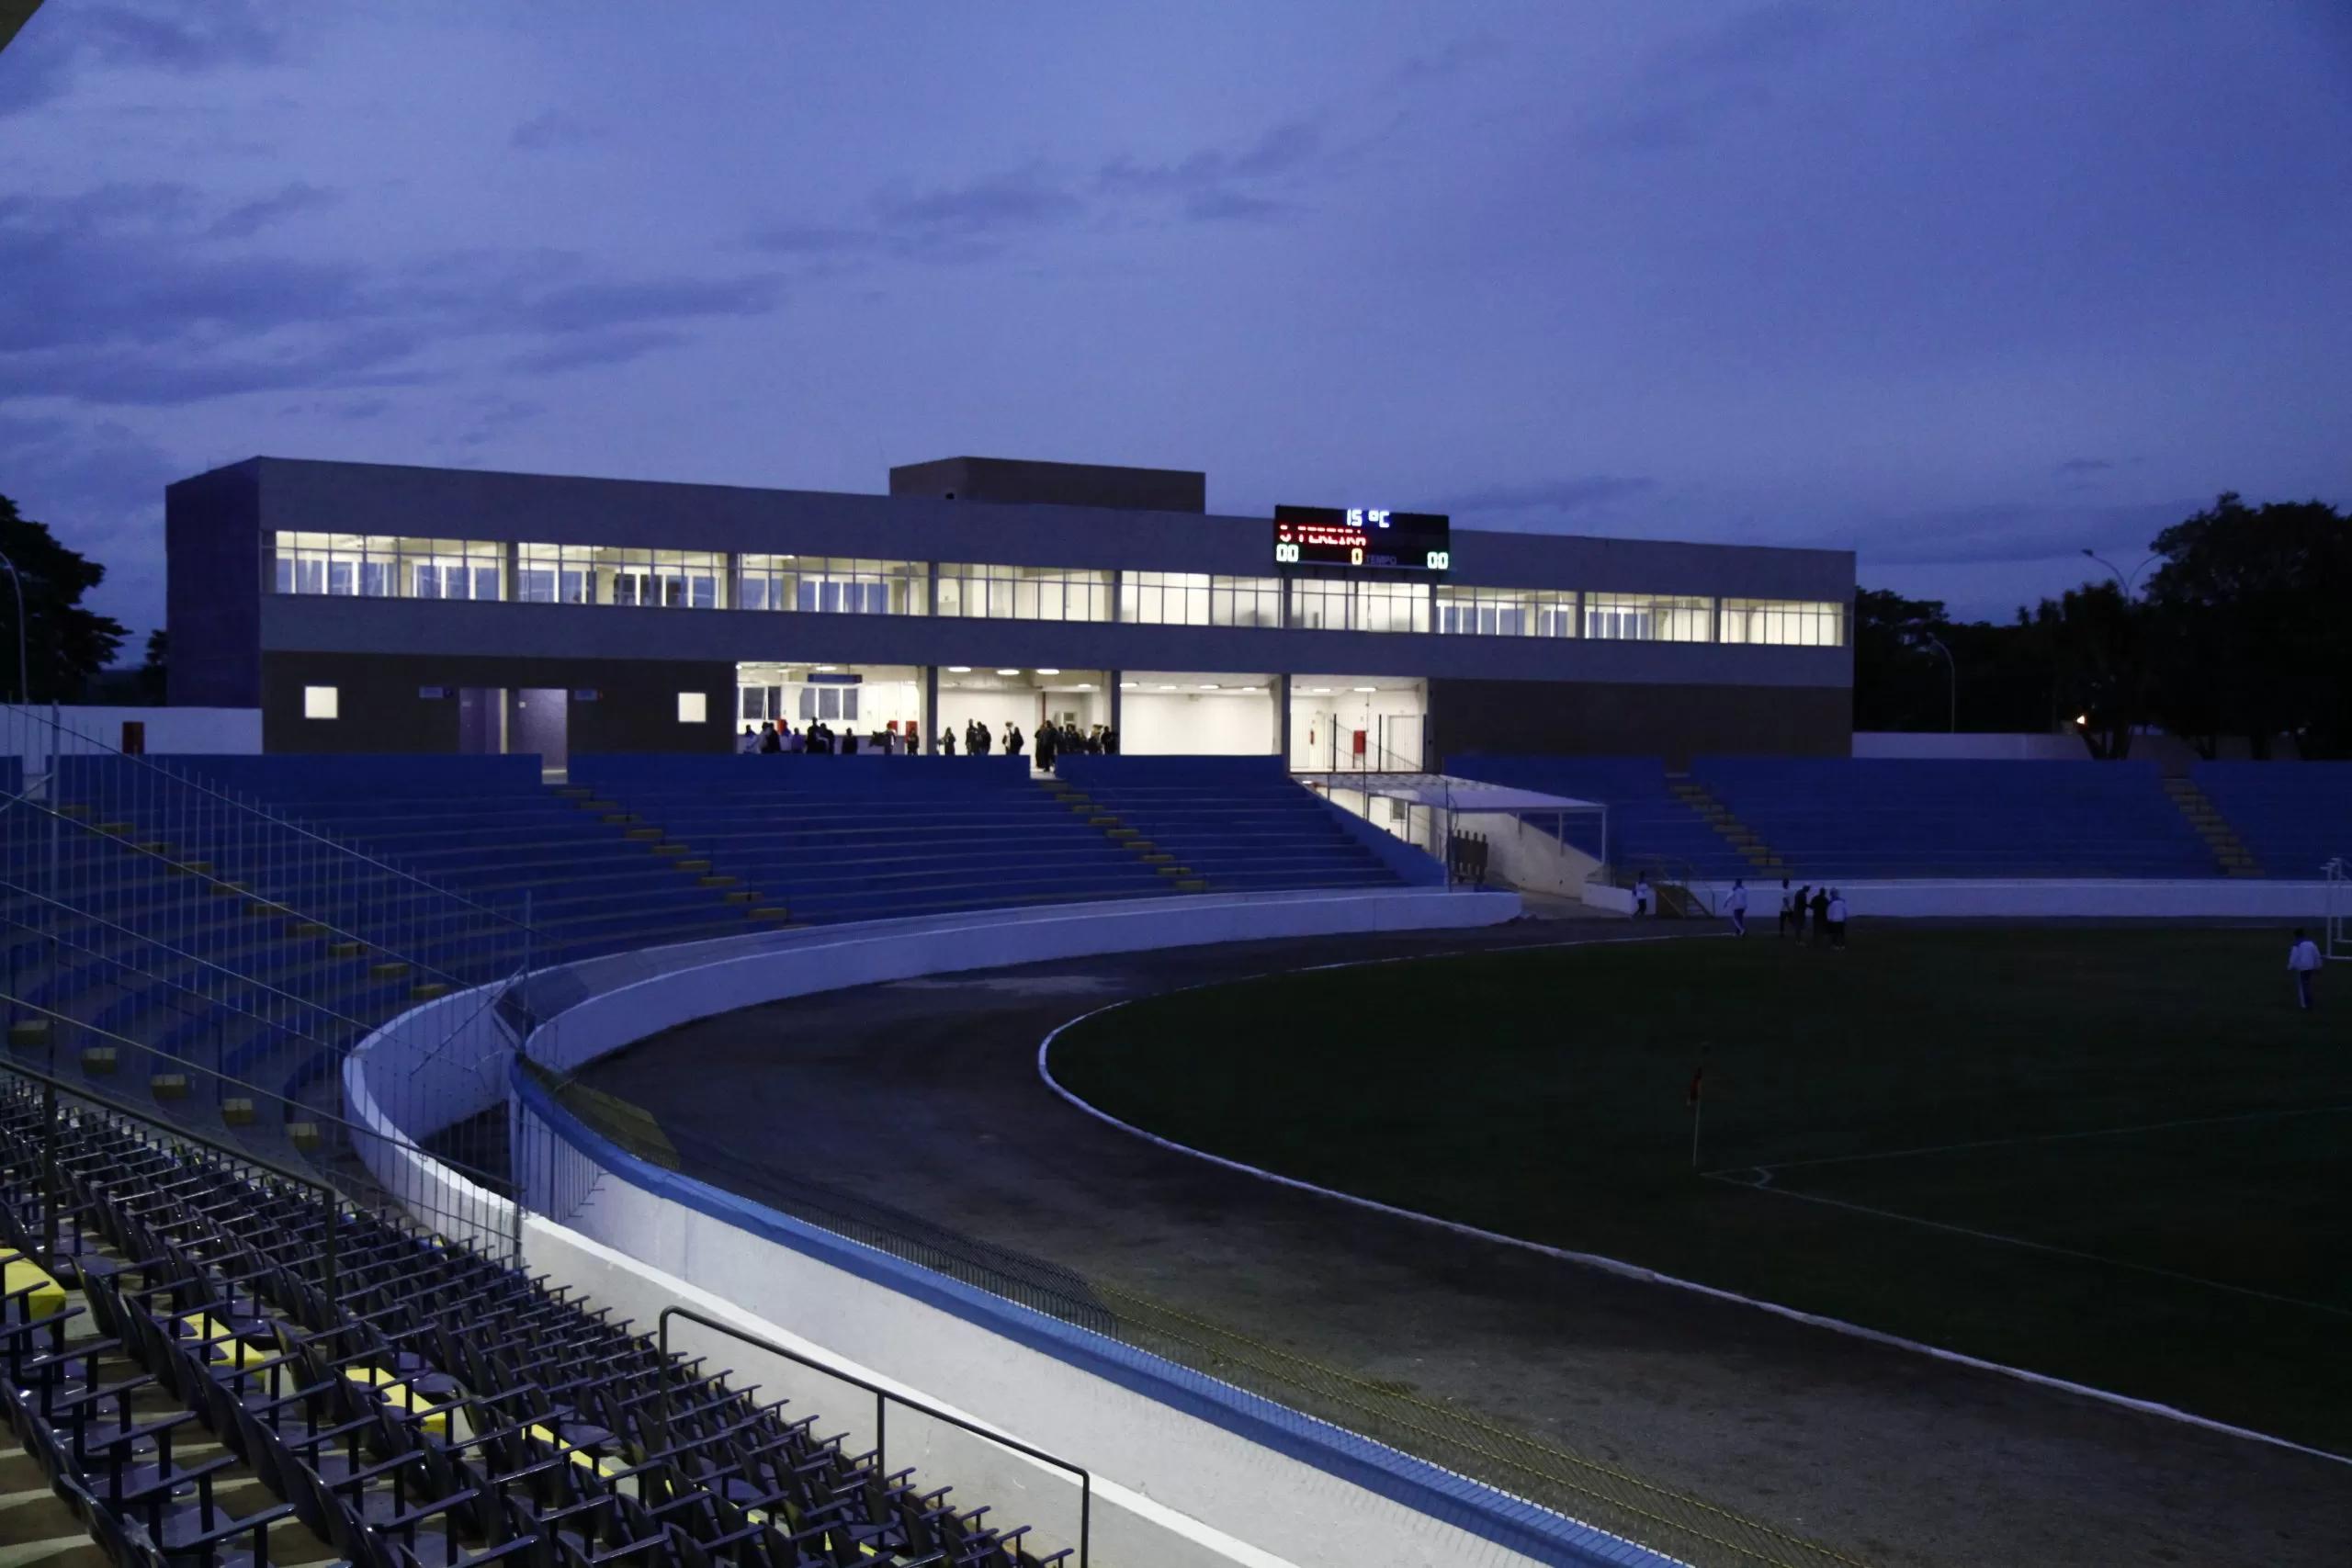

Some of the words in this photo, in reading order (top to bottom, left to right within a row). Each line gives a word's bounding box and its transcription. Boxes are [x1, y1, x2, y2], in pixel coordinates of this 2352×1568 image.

[1346, 509, 1363, 527] 15
[1275, 543, 1299, 562] 00
[1351, 547, 1363, 565] 0
[1427, 551, 1449, 570] 00
